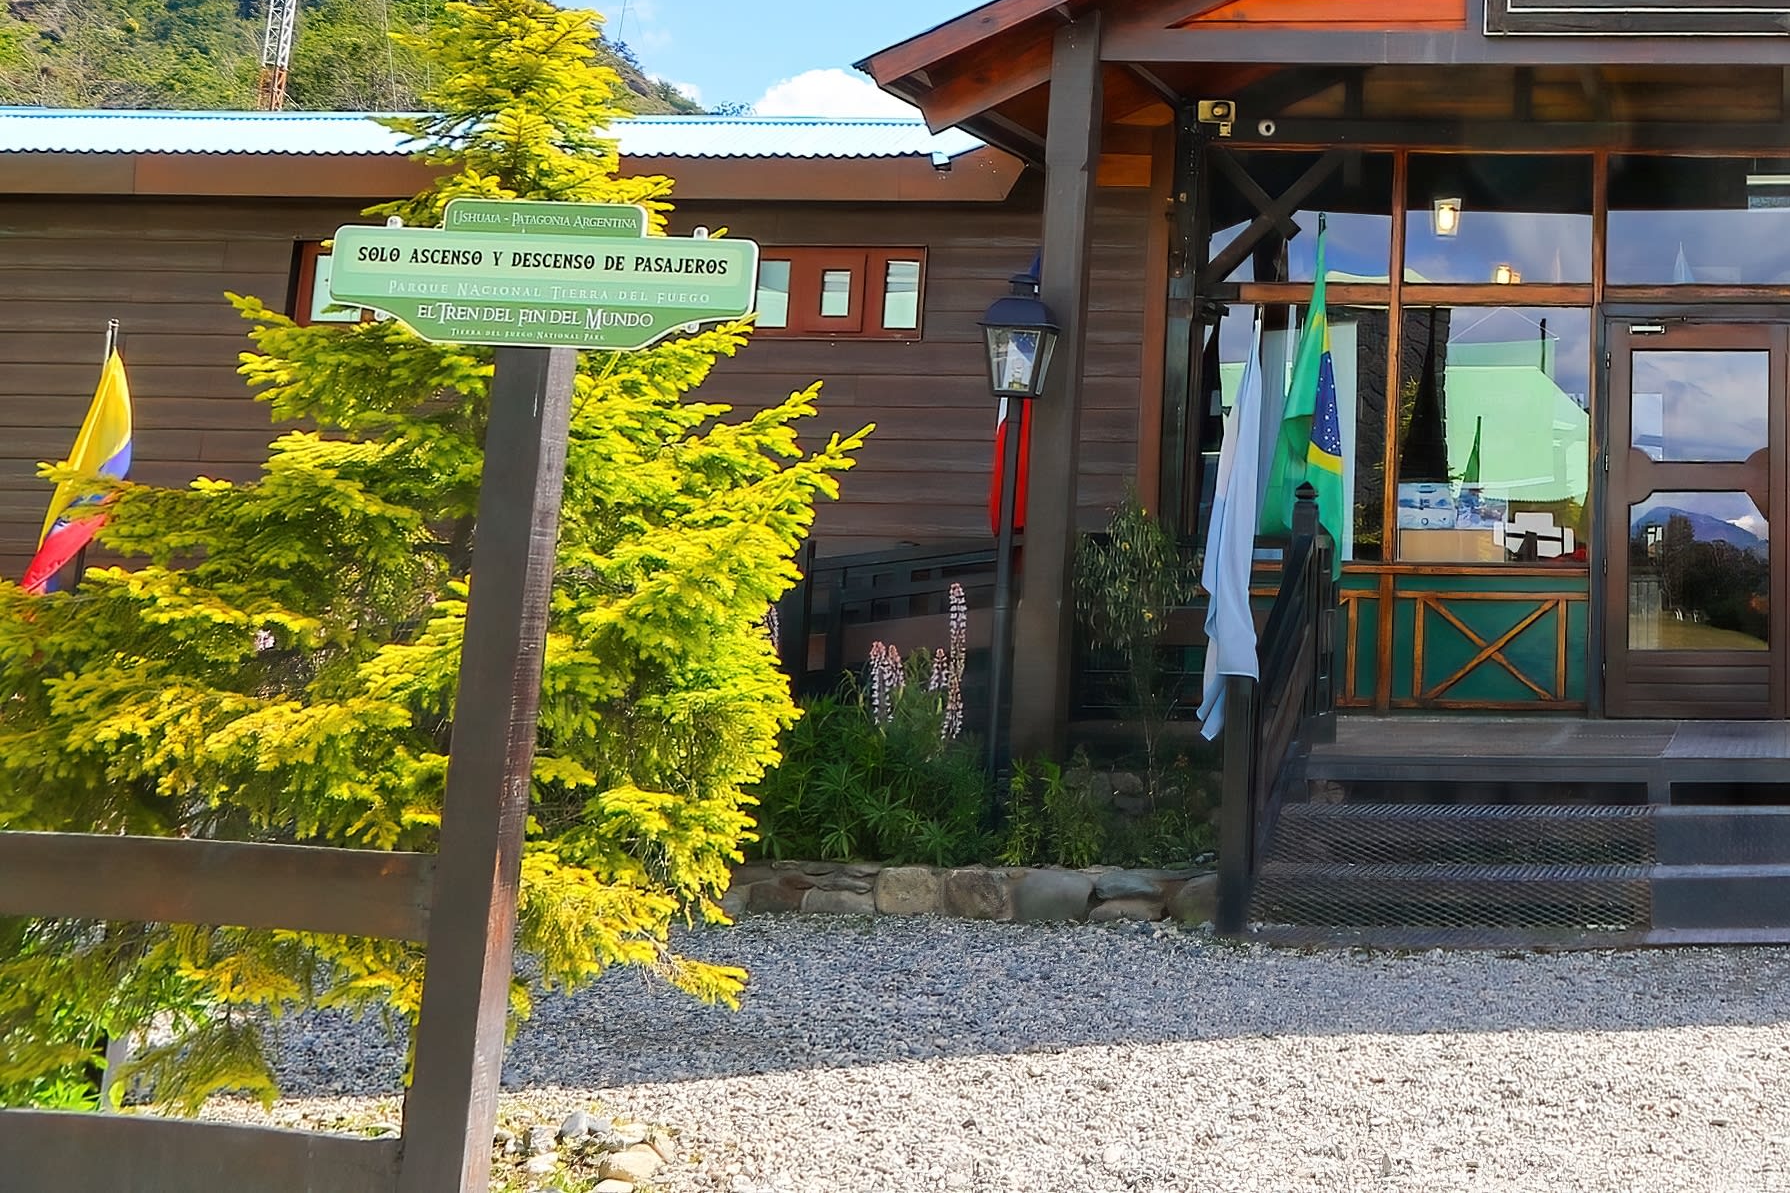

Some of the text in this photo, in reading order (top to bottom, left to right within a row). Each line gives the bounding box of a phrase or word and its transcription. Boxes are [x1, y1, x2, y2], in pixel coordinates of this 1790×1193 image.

[357, 246, 728, 275] SOLO ASCENSO Y DESCENSO DE PASAJEROS
[417, 304, 437, 319] EL
[483, 307, 514, 322] DEL
[518, 309, 546, 327] FIN
[549, 309, 582, 325] DEL
